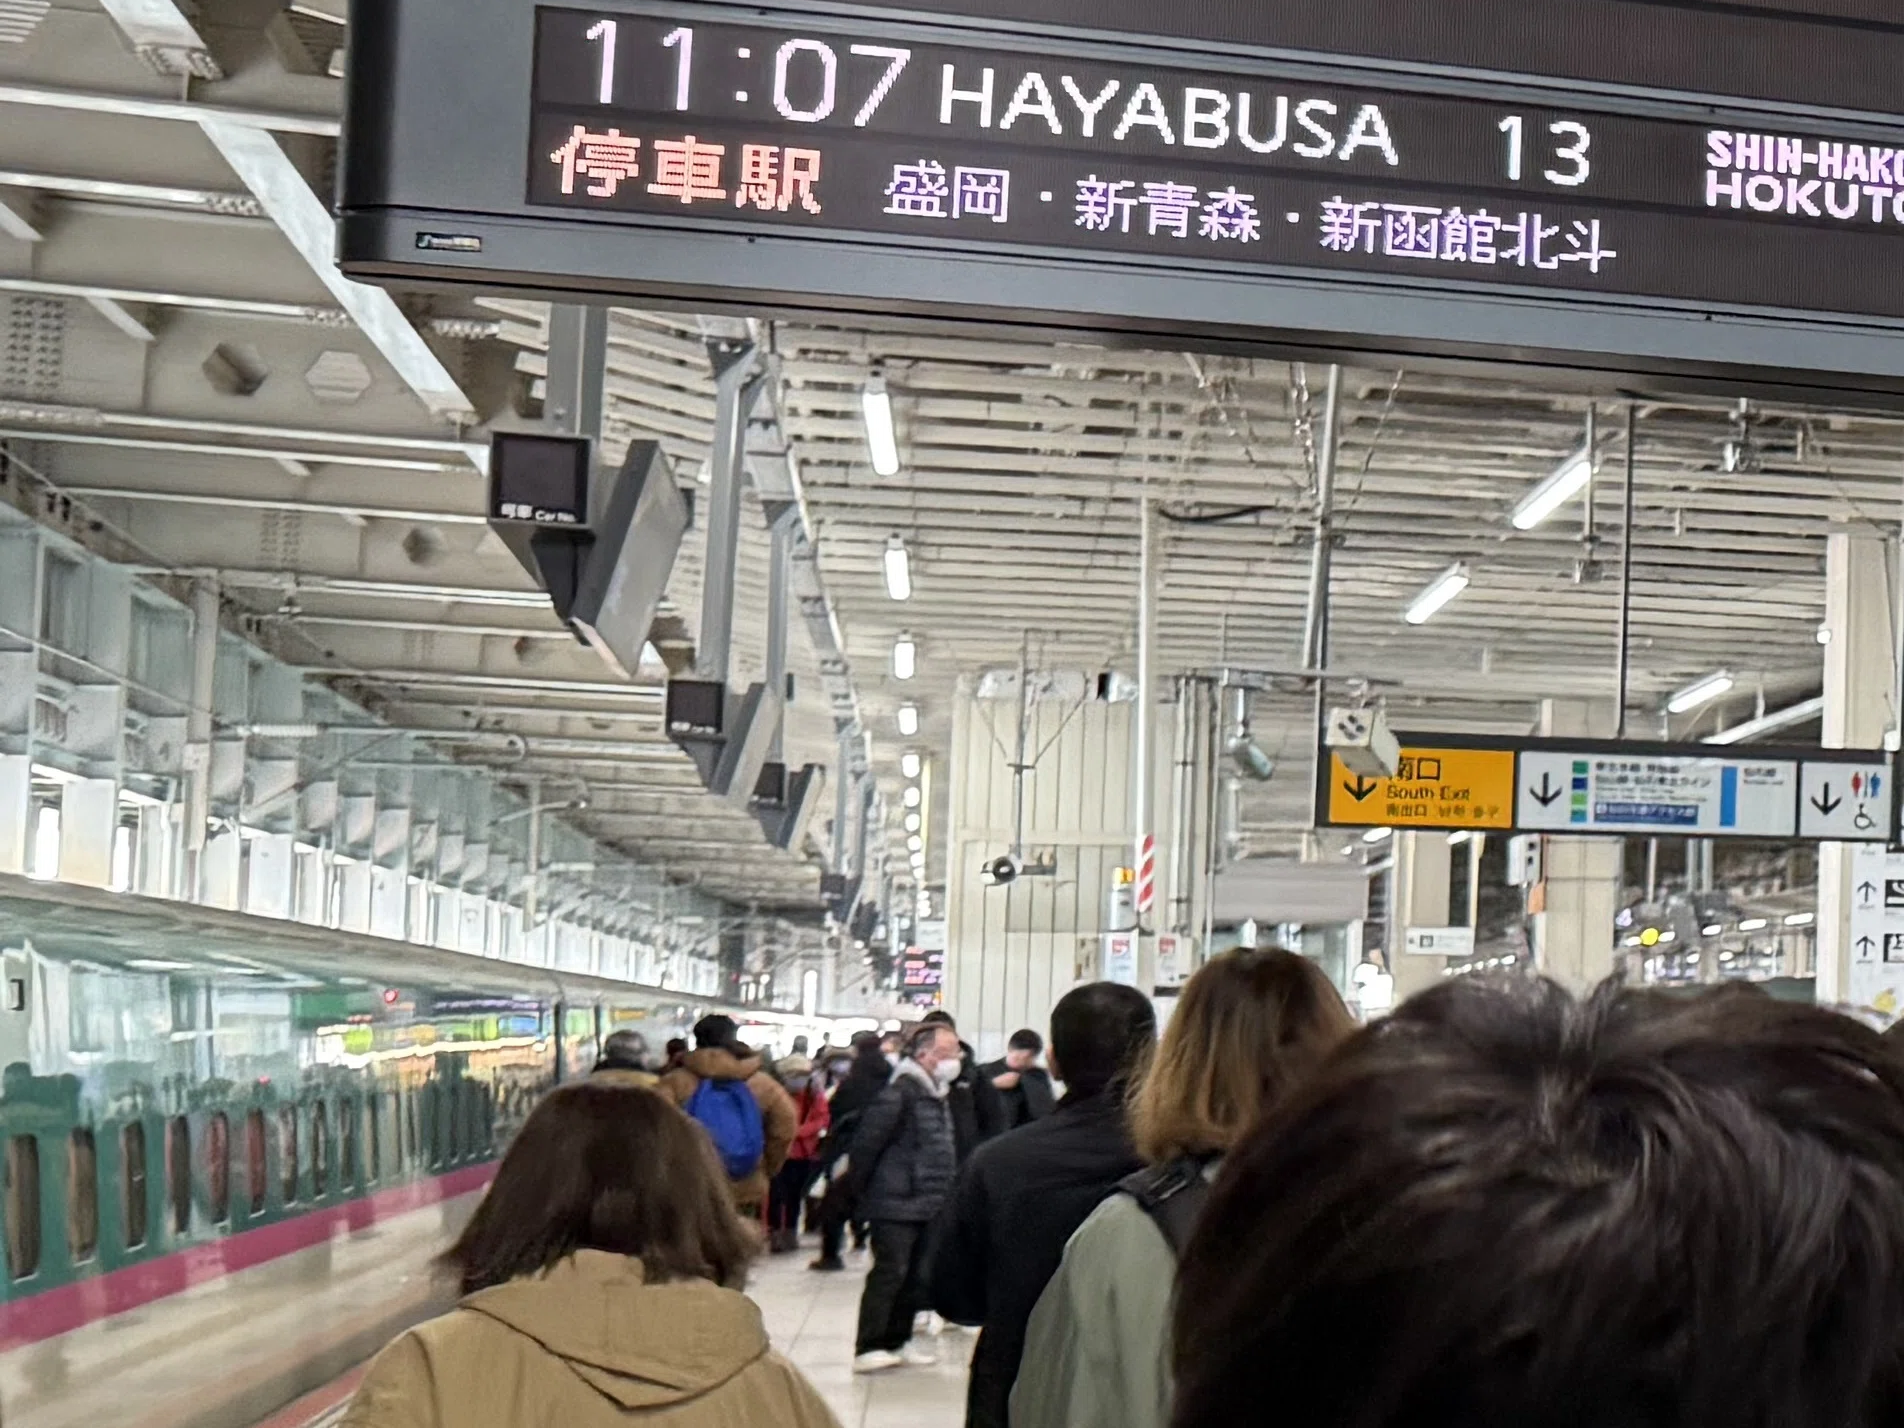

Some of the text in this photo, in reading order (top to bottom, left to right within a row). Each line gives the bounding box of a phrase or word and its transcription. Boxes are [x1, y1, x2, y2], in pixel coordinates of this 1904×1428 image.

[586, 19, 1592, 187] 11:07 HAYABUSA 13
[550, 125, 821, 215] 停車駅
[1386, 784, 1434, 800] South
